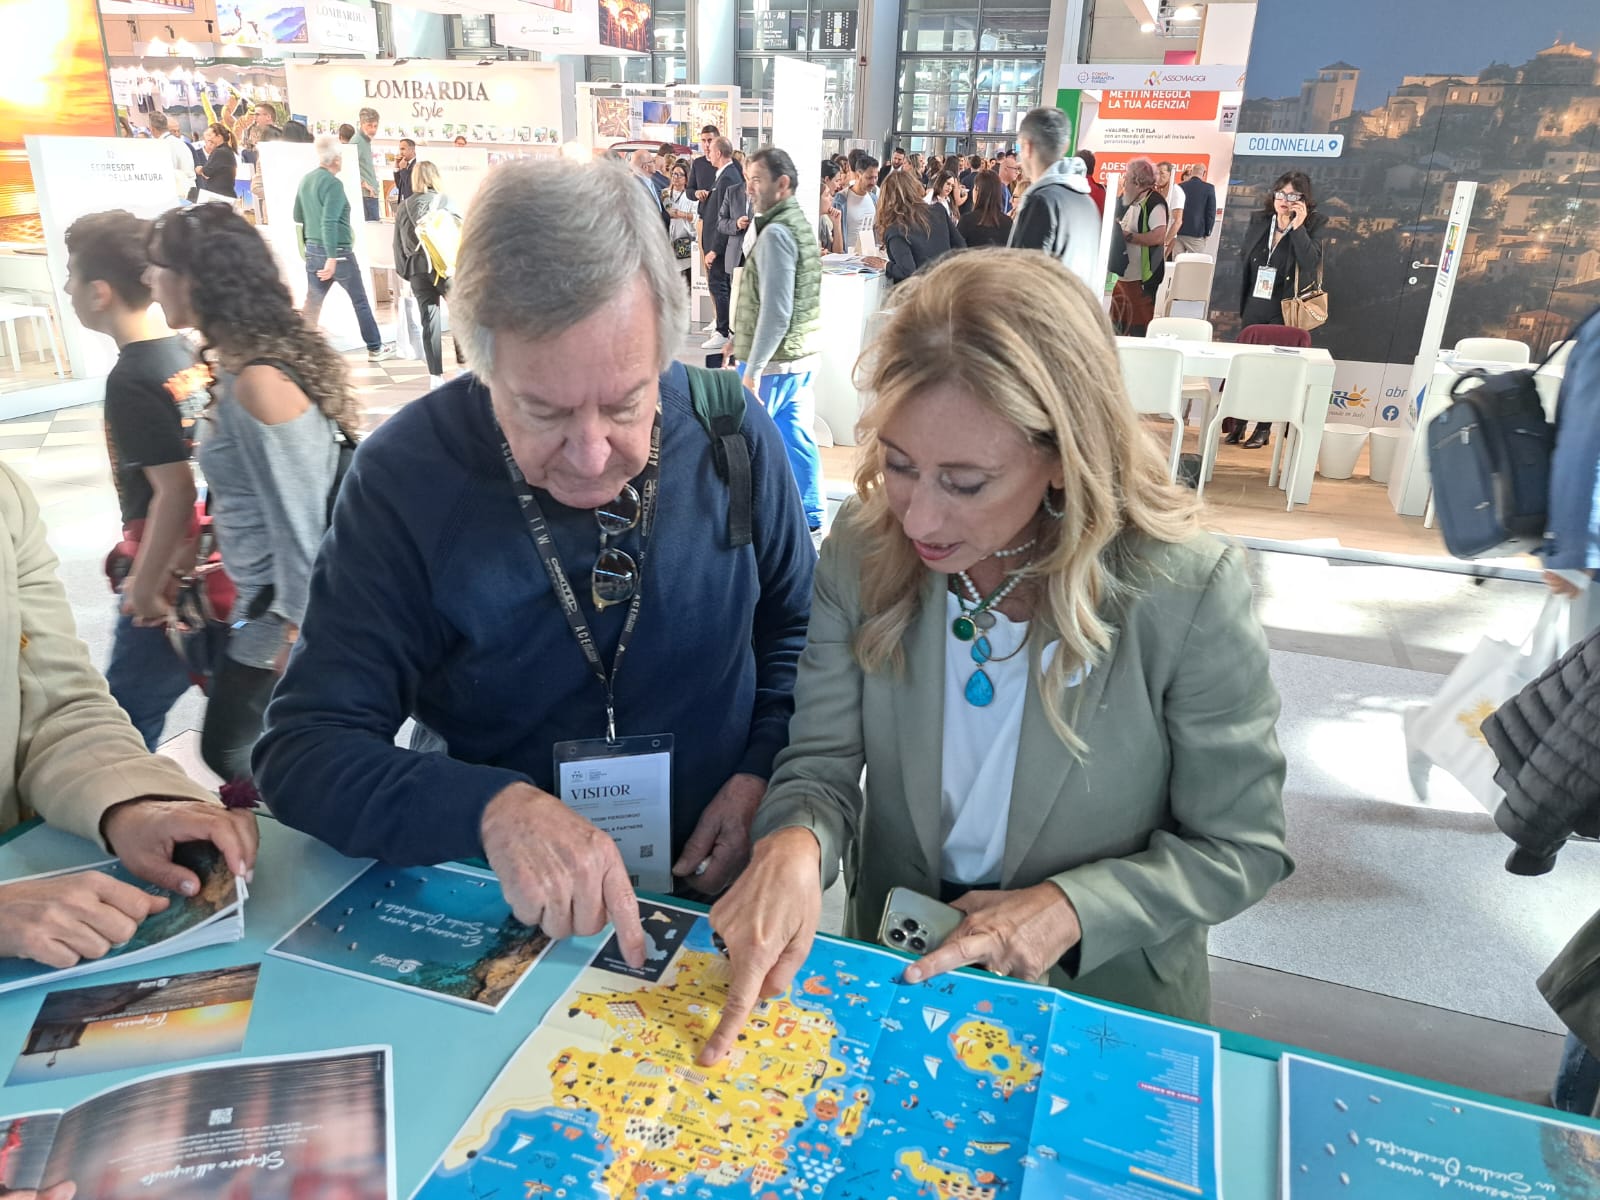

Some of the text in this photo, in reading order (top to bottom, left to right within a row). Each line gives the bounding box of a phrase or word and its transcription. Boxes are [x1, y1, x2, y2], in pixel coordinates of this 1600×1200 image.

[364, 79, 490, 101] LOMBARDIA
[1109, 90, 1191, 98] METTI IN REGOLA
[411, 101, 444, 122] Style
[1108, 100, 1190, 110] LA TUA AGENZIA!
[1248, 137, 1325, 152] COLONNELLA
[134, 173, 163, 181] NATURA
[570, 784, 631, 800] VISITOR
[377, 914, 409, 927] vivere
[426, 925, 484, 948] Emozioni
[218, 1150, 285, 1170] Stupore
[1365, 1137, 1556, 1194] Occidentale Sicilia in
[1375, 1156, 1424, 1178] vivere
[1427, 1171, 1450, 1188] da
